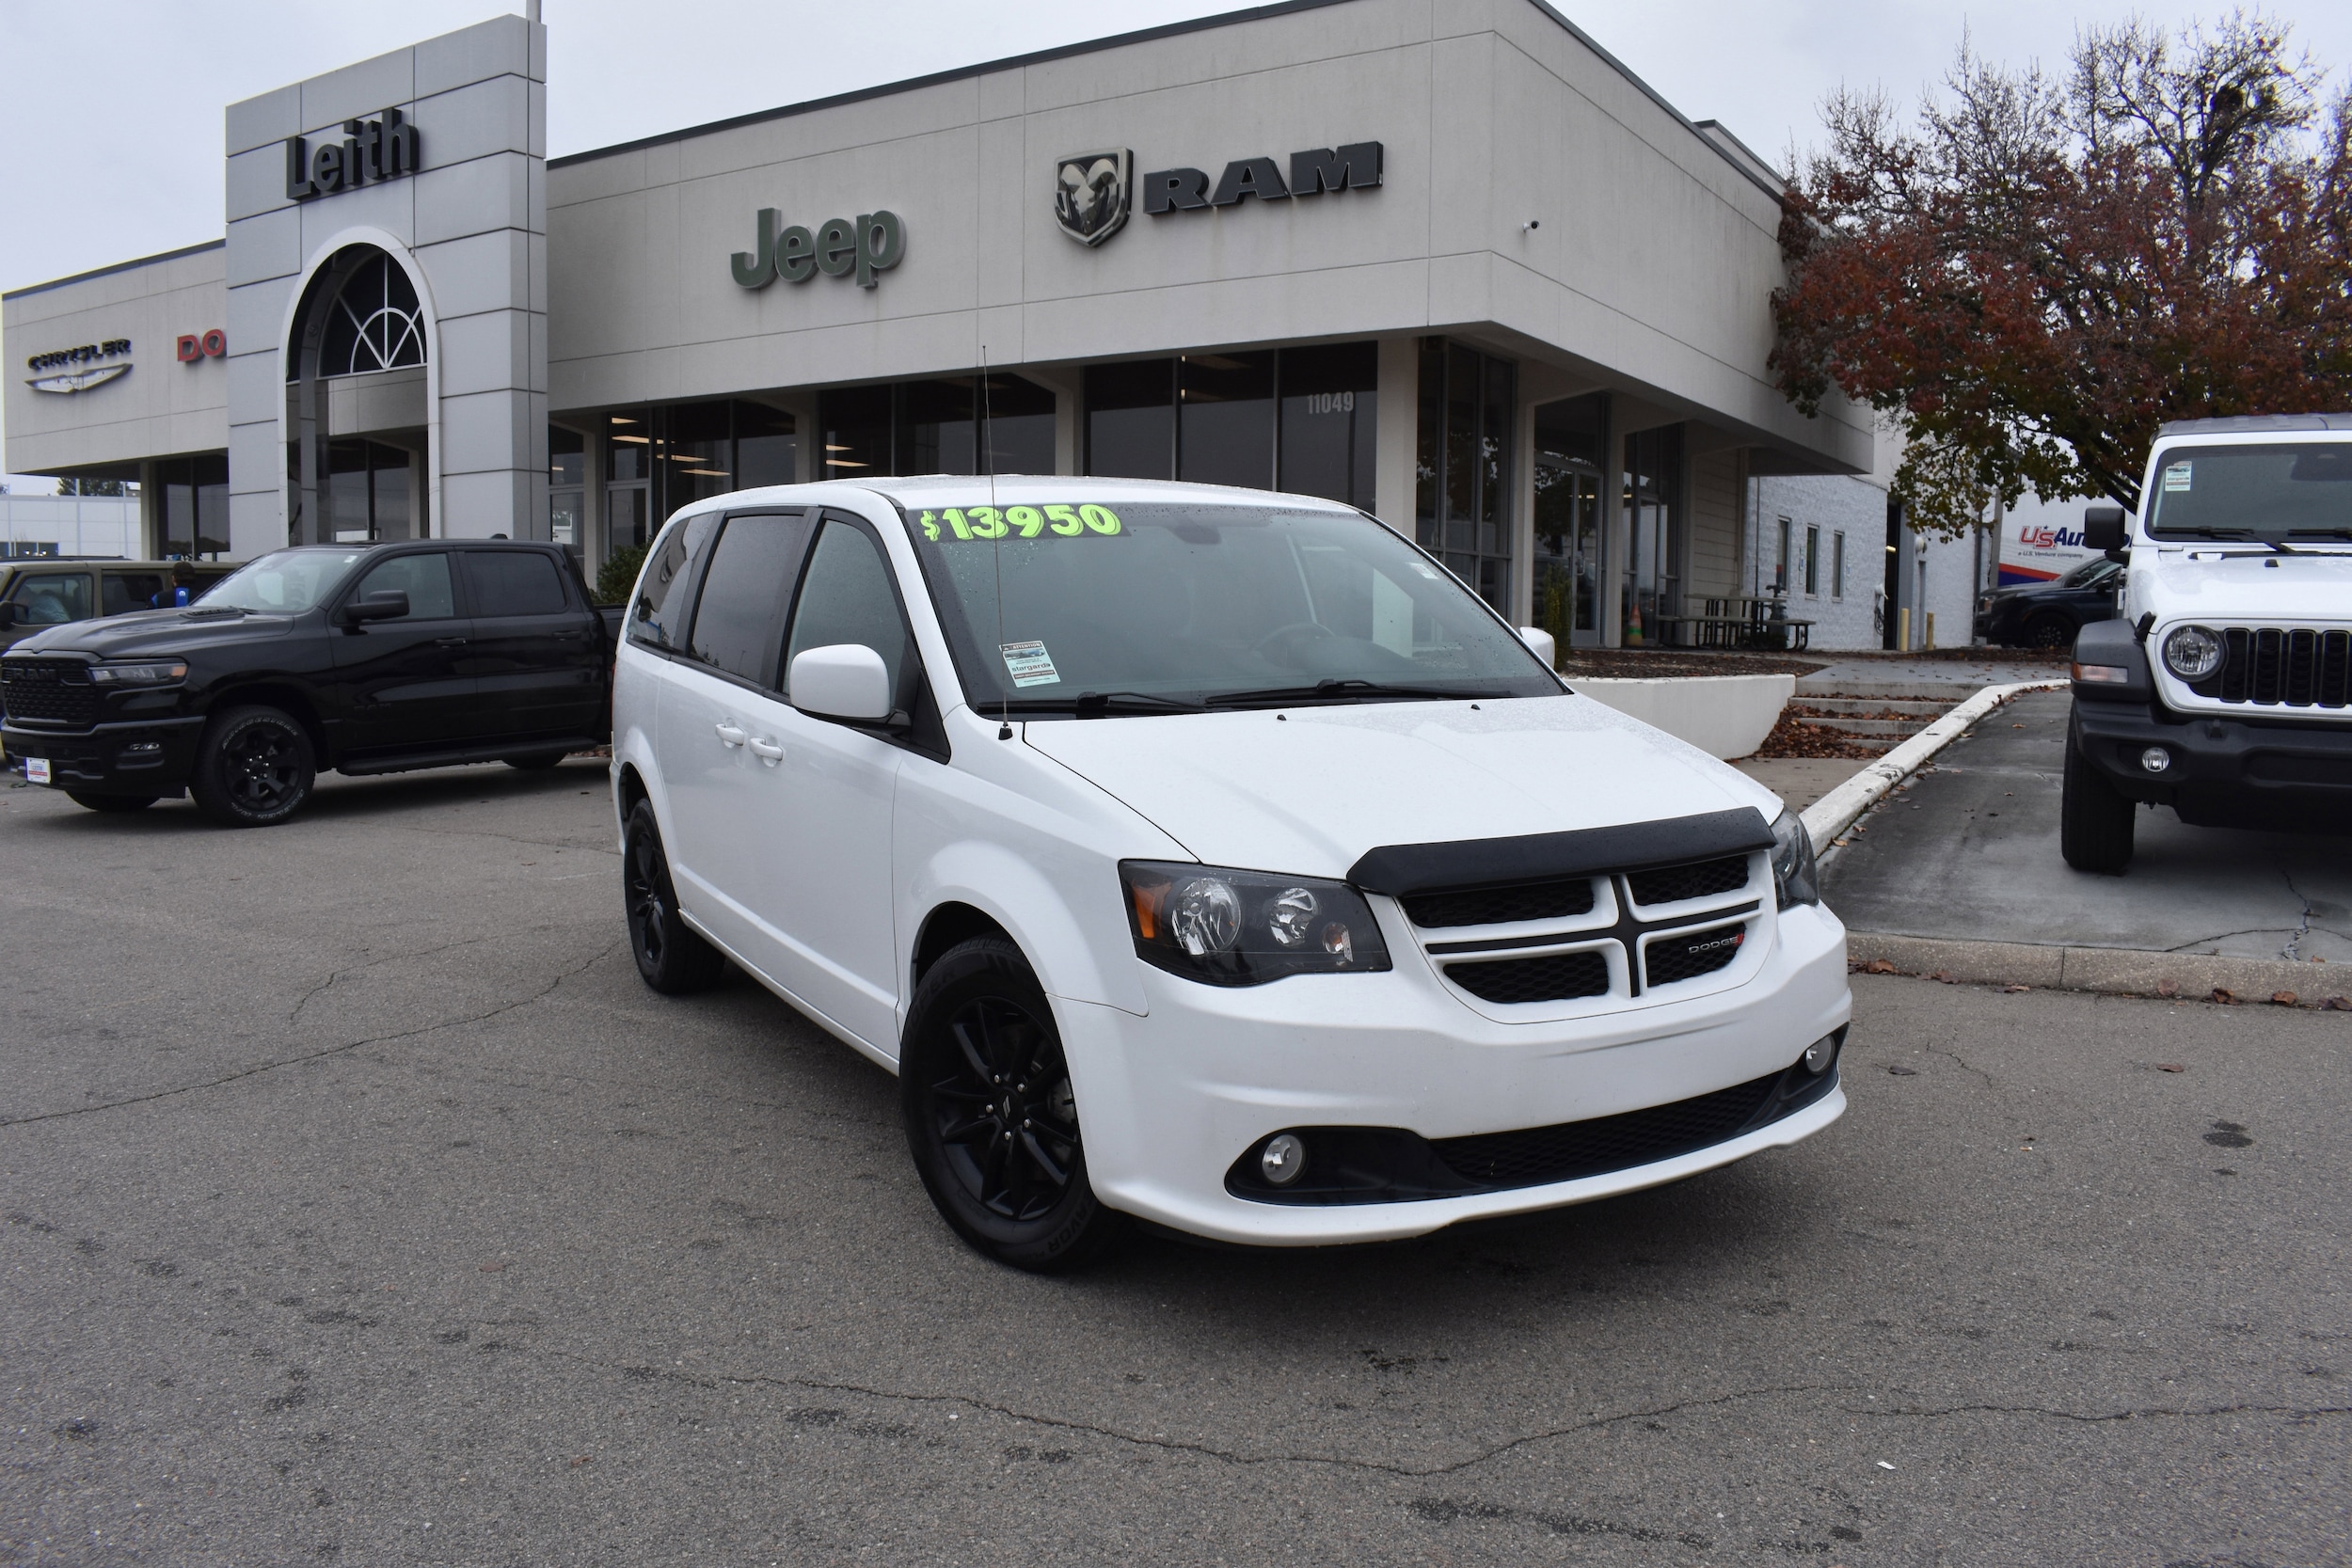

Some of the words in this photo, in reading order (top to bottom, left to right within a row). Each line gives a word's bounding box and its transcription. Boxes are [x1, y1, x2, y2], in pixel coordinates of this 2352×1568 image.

[286, 106, 420, 200] Leith
[1143, 141, 1384, 215] RAM
[730, 208, 907, 289] Jeep
[27, 338, 132, 371] CHRYSLER
[1307, 390, 1354, 415] 11049
[920, 503, 1122, 543] $13950
[1688, 936, 1739, 954] DODGE
